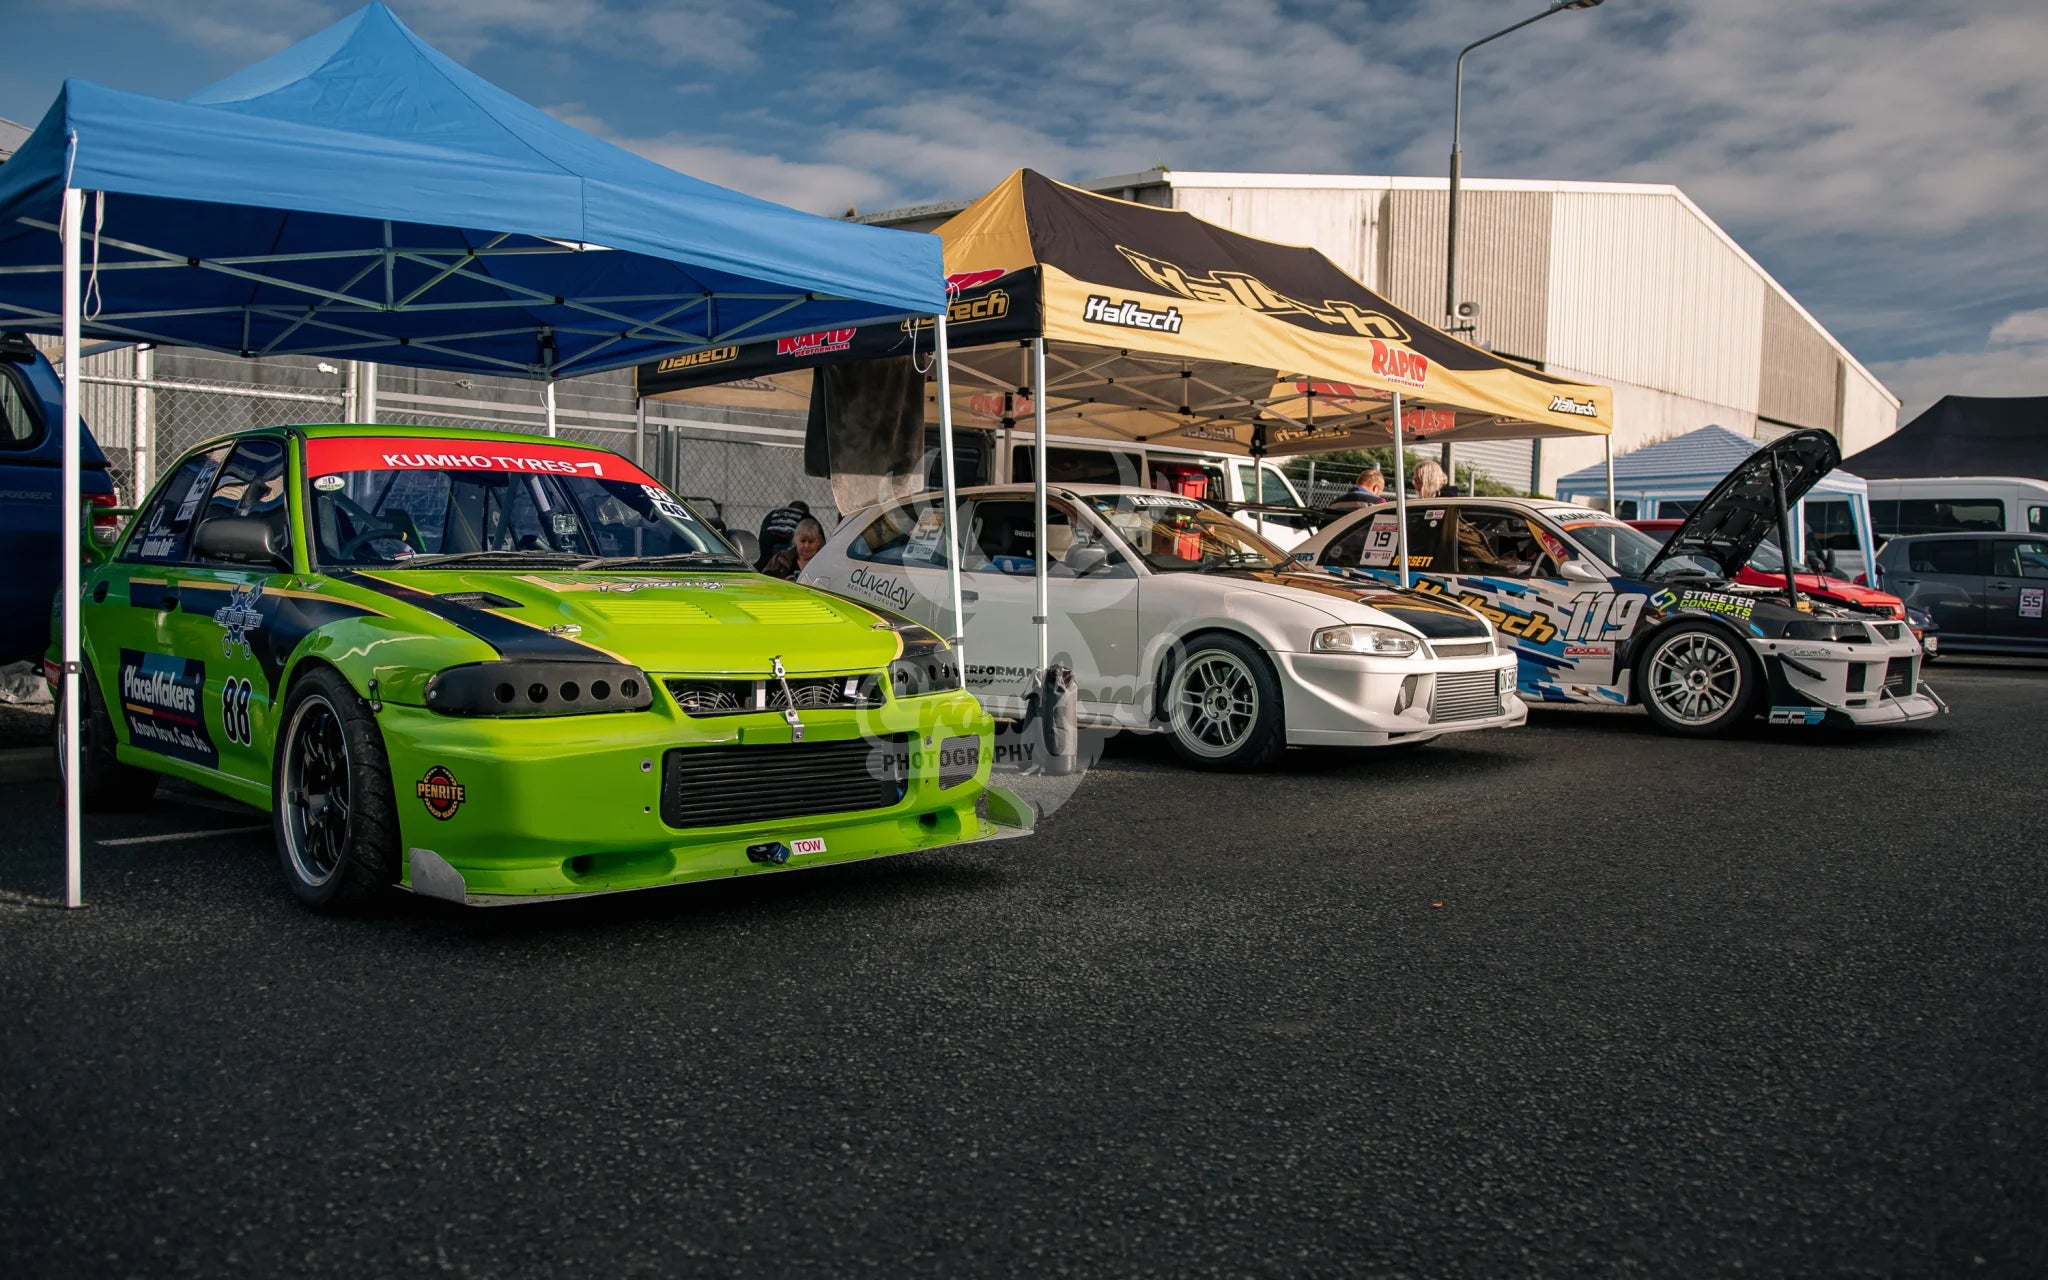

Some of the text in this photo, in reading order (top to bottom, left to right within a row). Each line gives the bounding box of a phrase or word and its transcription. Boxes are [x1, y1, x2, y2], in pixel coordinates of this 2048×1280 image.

[1085, 296, 1182, 332] Haltech
[795, 343, 849, 357] PERFORMANCE
[1369, 340, 1427, 382] RAPID
[1387, 377, 1425, 389] PERFORMANCE
[1549, 396, 1597, 417] Haltech
[382, 454, 578, 474] KUMHO TYRES
[640, 484, 674, 503] 88
[1130, 494, 1201, 509] Haltech
[660, 503, 688, 518] 46
[1374, 532, 1391, 547] 19
[850, 565, 916, 610] duvalay
[1680, 599, 1752, 617] CONCEPTS
[1683, 590, 1756, 608] STREETER
[1563, 592, 1647, 642] 119
[124, 664, 196, 714] PlaceMakers
[222, 676, 252, 748] 88
[130, 715, 156, 740] Know
[175, 726, 194, 748] Can
[192, 731, 211, 753] do.
[417, 783, 464, 801] PENRITE
[795, 840, 821, 852] TOW
